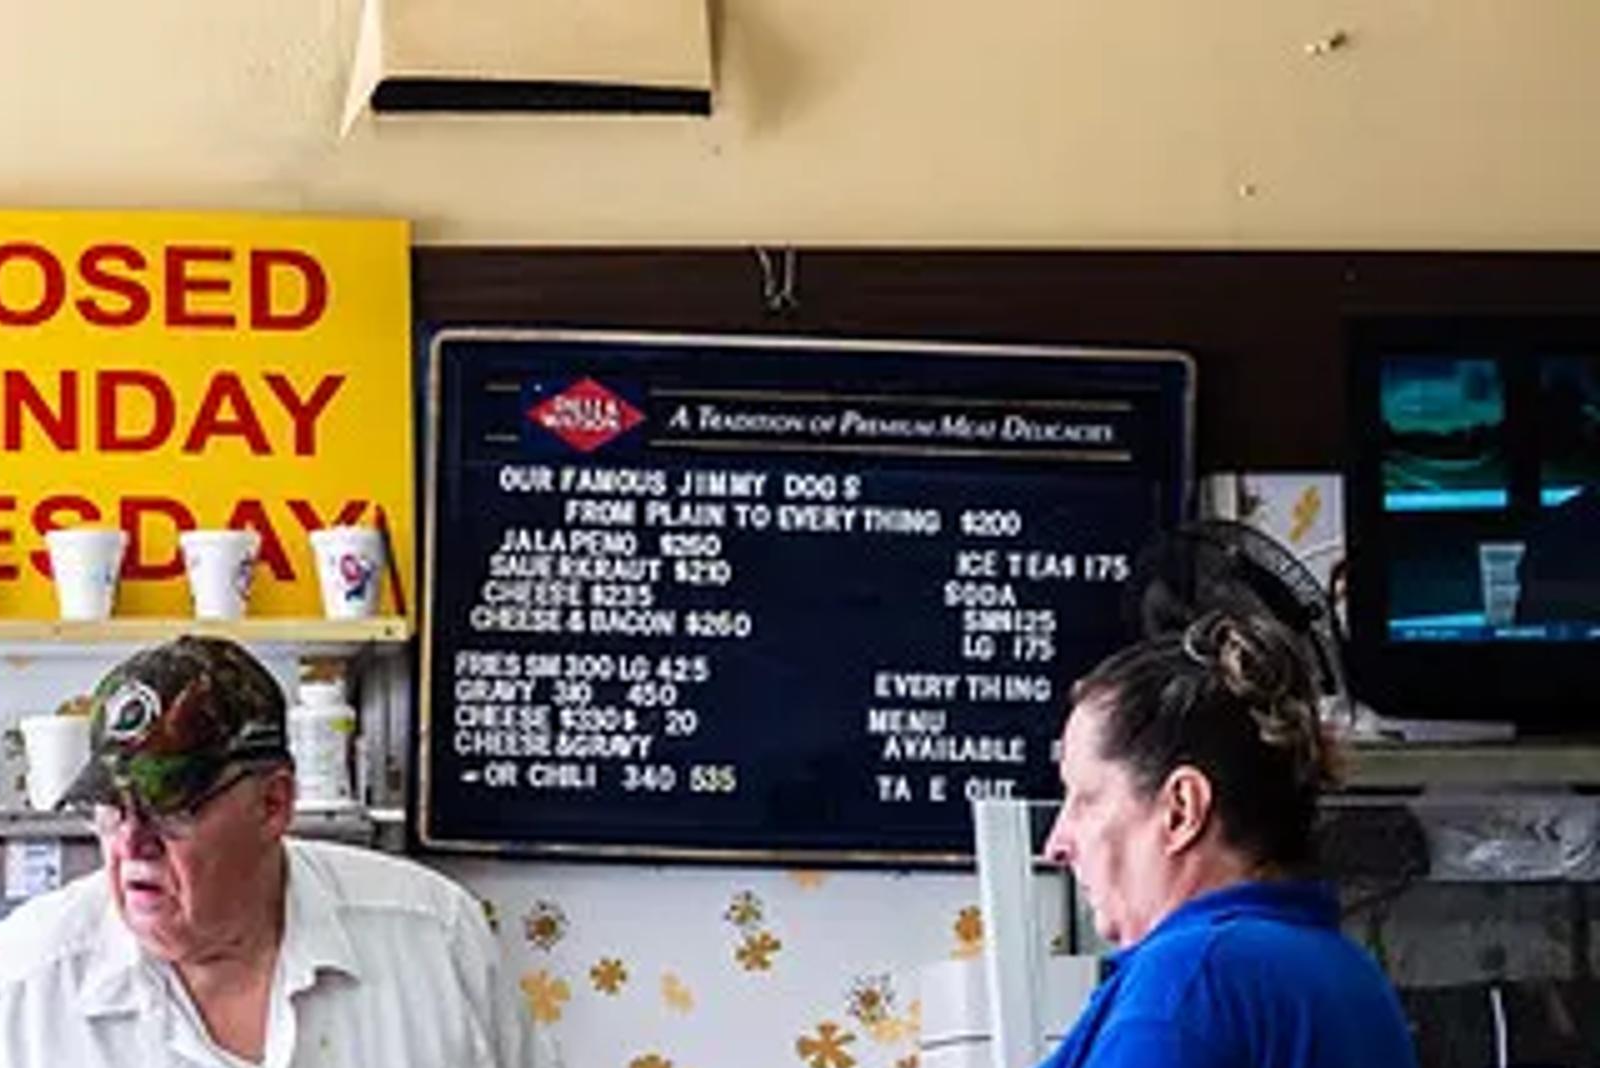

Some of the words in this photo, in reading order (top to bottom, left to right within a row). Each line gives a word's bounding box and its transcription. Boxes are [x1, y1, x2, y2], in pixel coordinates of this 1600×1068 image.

[668, 404, 691, 430] A
[499, 465, 553, 492] OUR
[560, 466, 667, 496] FAMOUS
[679, 470, 767, 497] JIMMY
[565, 500, 635, 526] FROM
[646, 501, 725, 527] PLAIN
[734, 504, 771, 529] TO
[500, 529, 637, 557] JALAPENO
[955, 550, 998, 577] ICE
[481, 580, 582, 606] CHEESE
[469, 605, 562, 632] CHEESE
[589, 609, 677, 636] BACON
[454, 650, 521, 678] FRIES
[454, 679, 537, 702] GRAVY
[454, 704, 551, 729] CHEESE
[867, 708, 948, 735] MENU
[454, 729, 552, 757] CHEESE
[883, 734, 1027, 763] AVAILABLE
[528, 762, 597, 789] CHILI
[963, 774, 1017, 801] OUT
